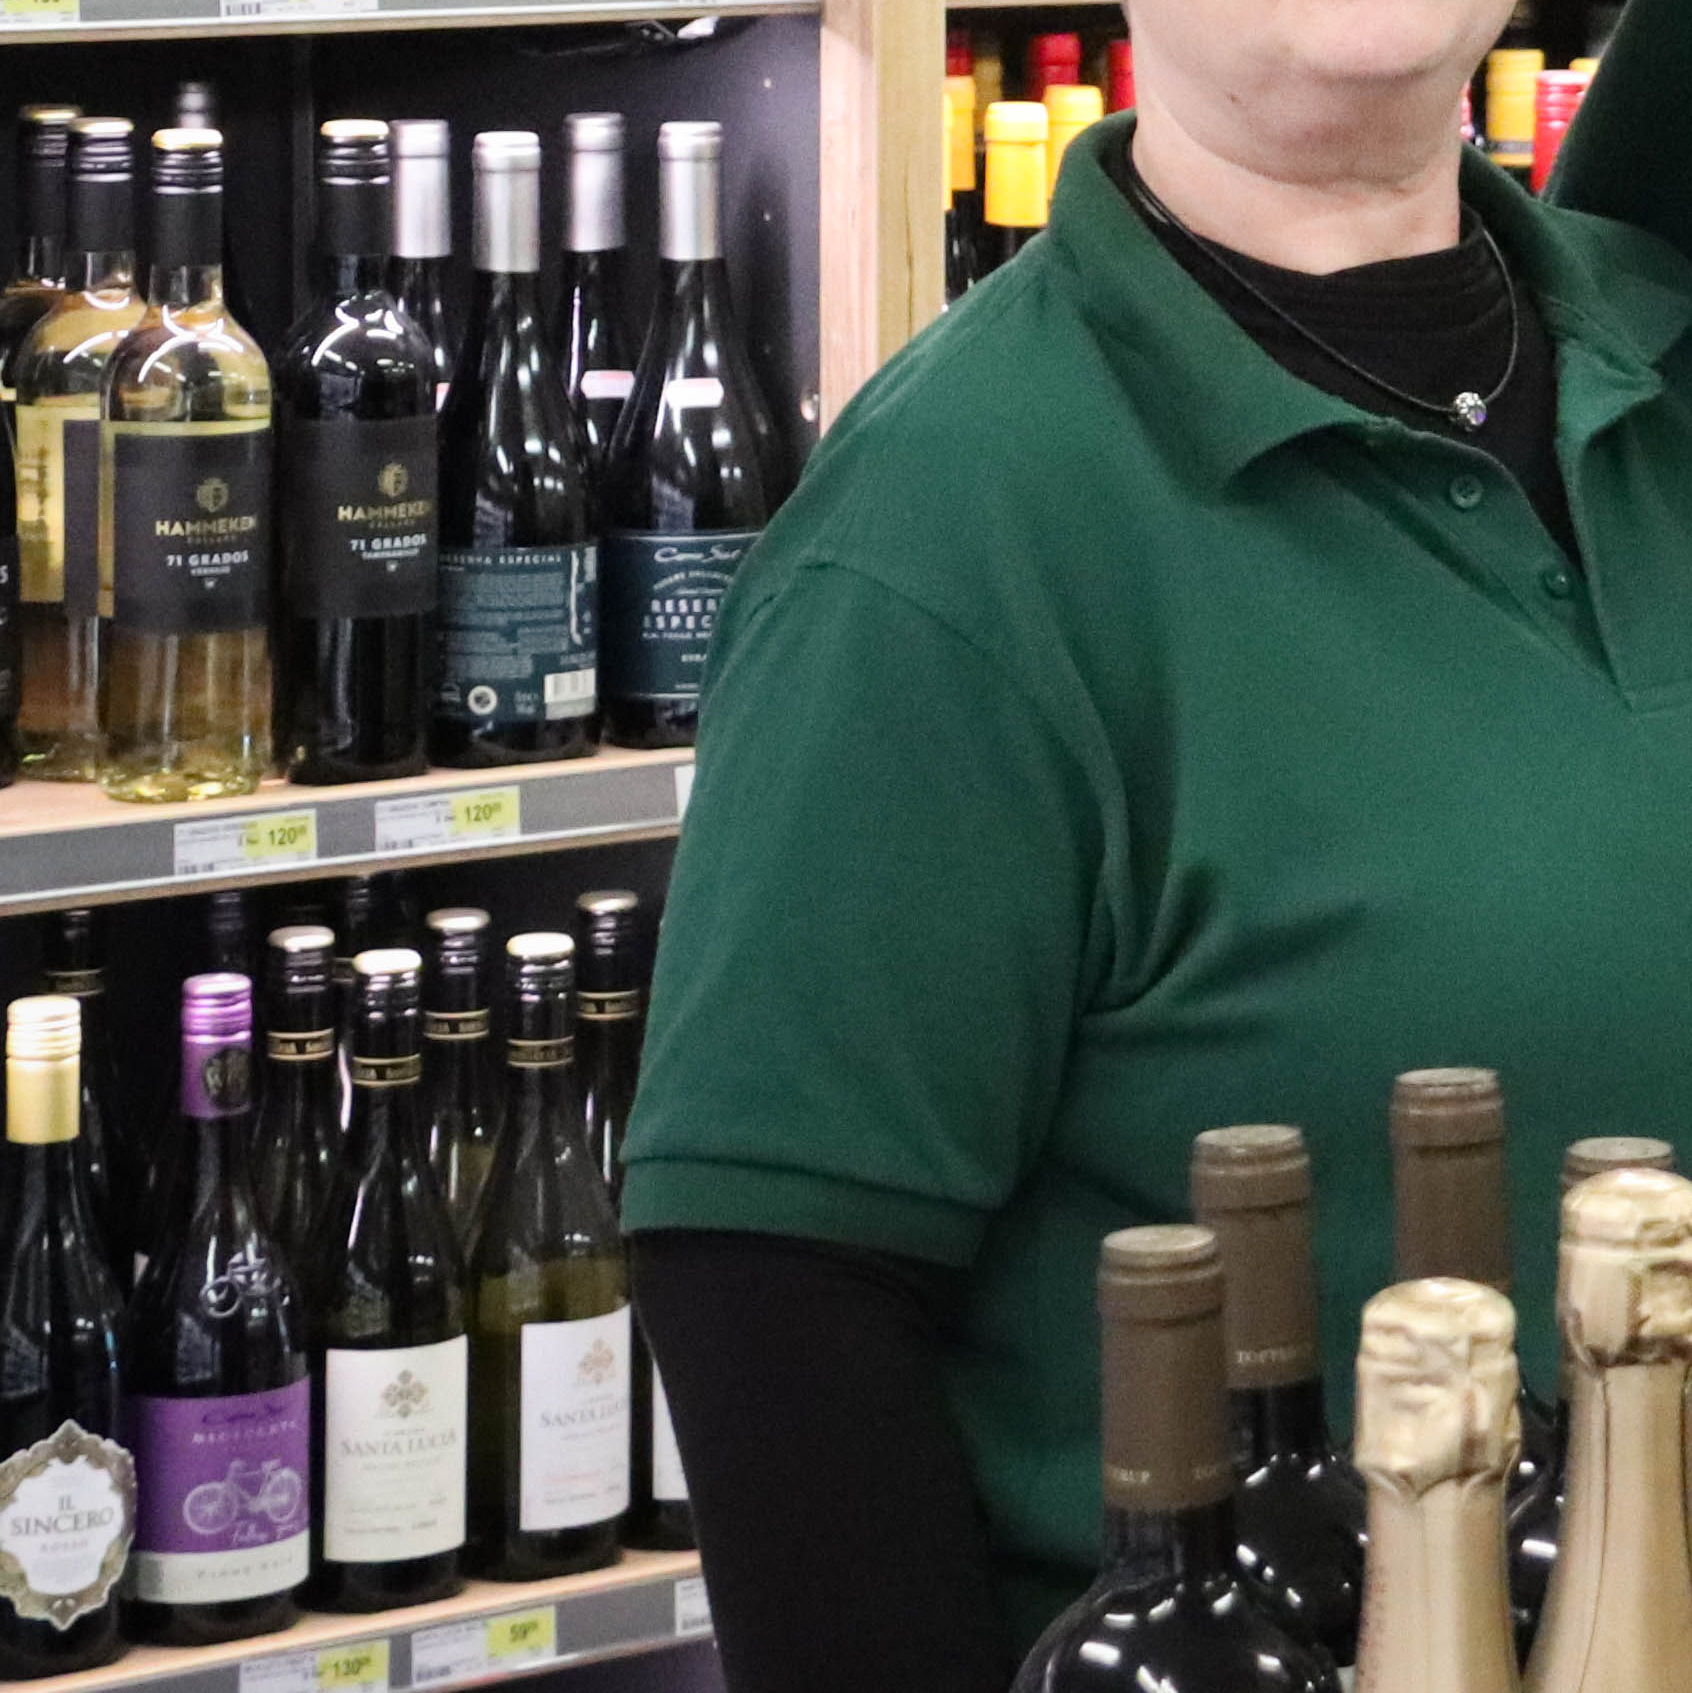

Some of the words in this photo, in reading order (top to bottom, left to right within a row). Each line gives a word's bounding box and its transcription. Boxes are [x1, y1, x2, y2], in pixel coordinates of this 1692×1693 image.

[370, 533, 428, 551] GRADOS
[188, 549, 249, 566] GRADOS
[10, 1507, 115, 1537] SINCERO
